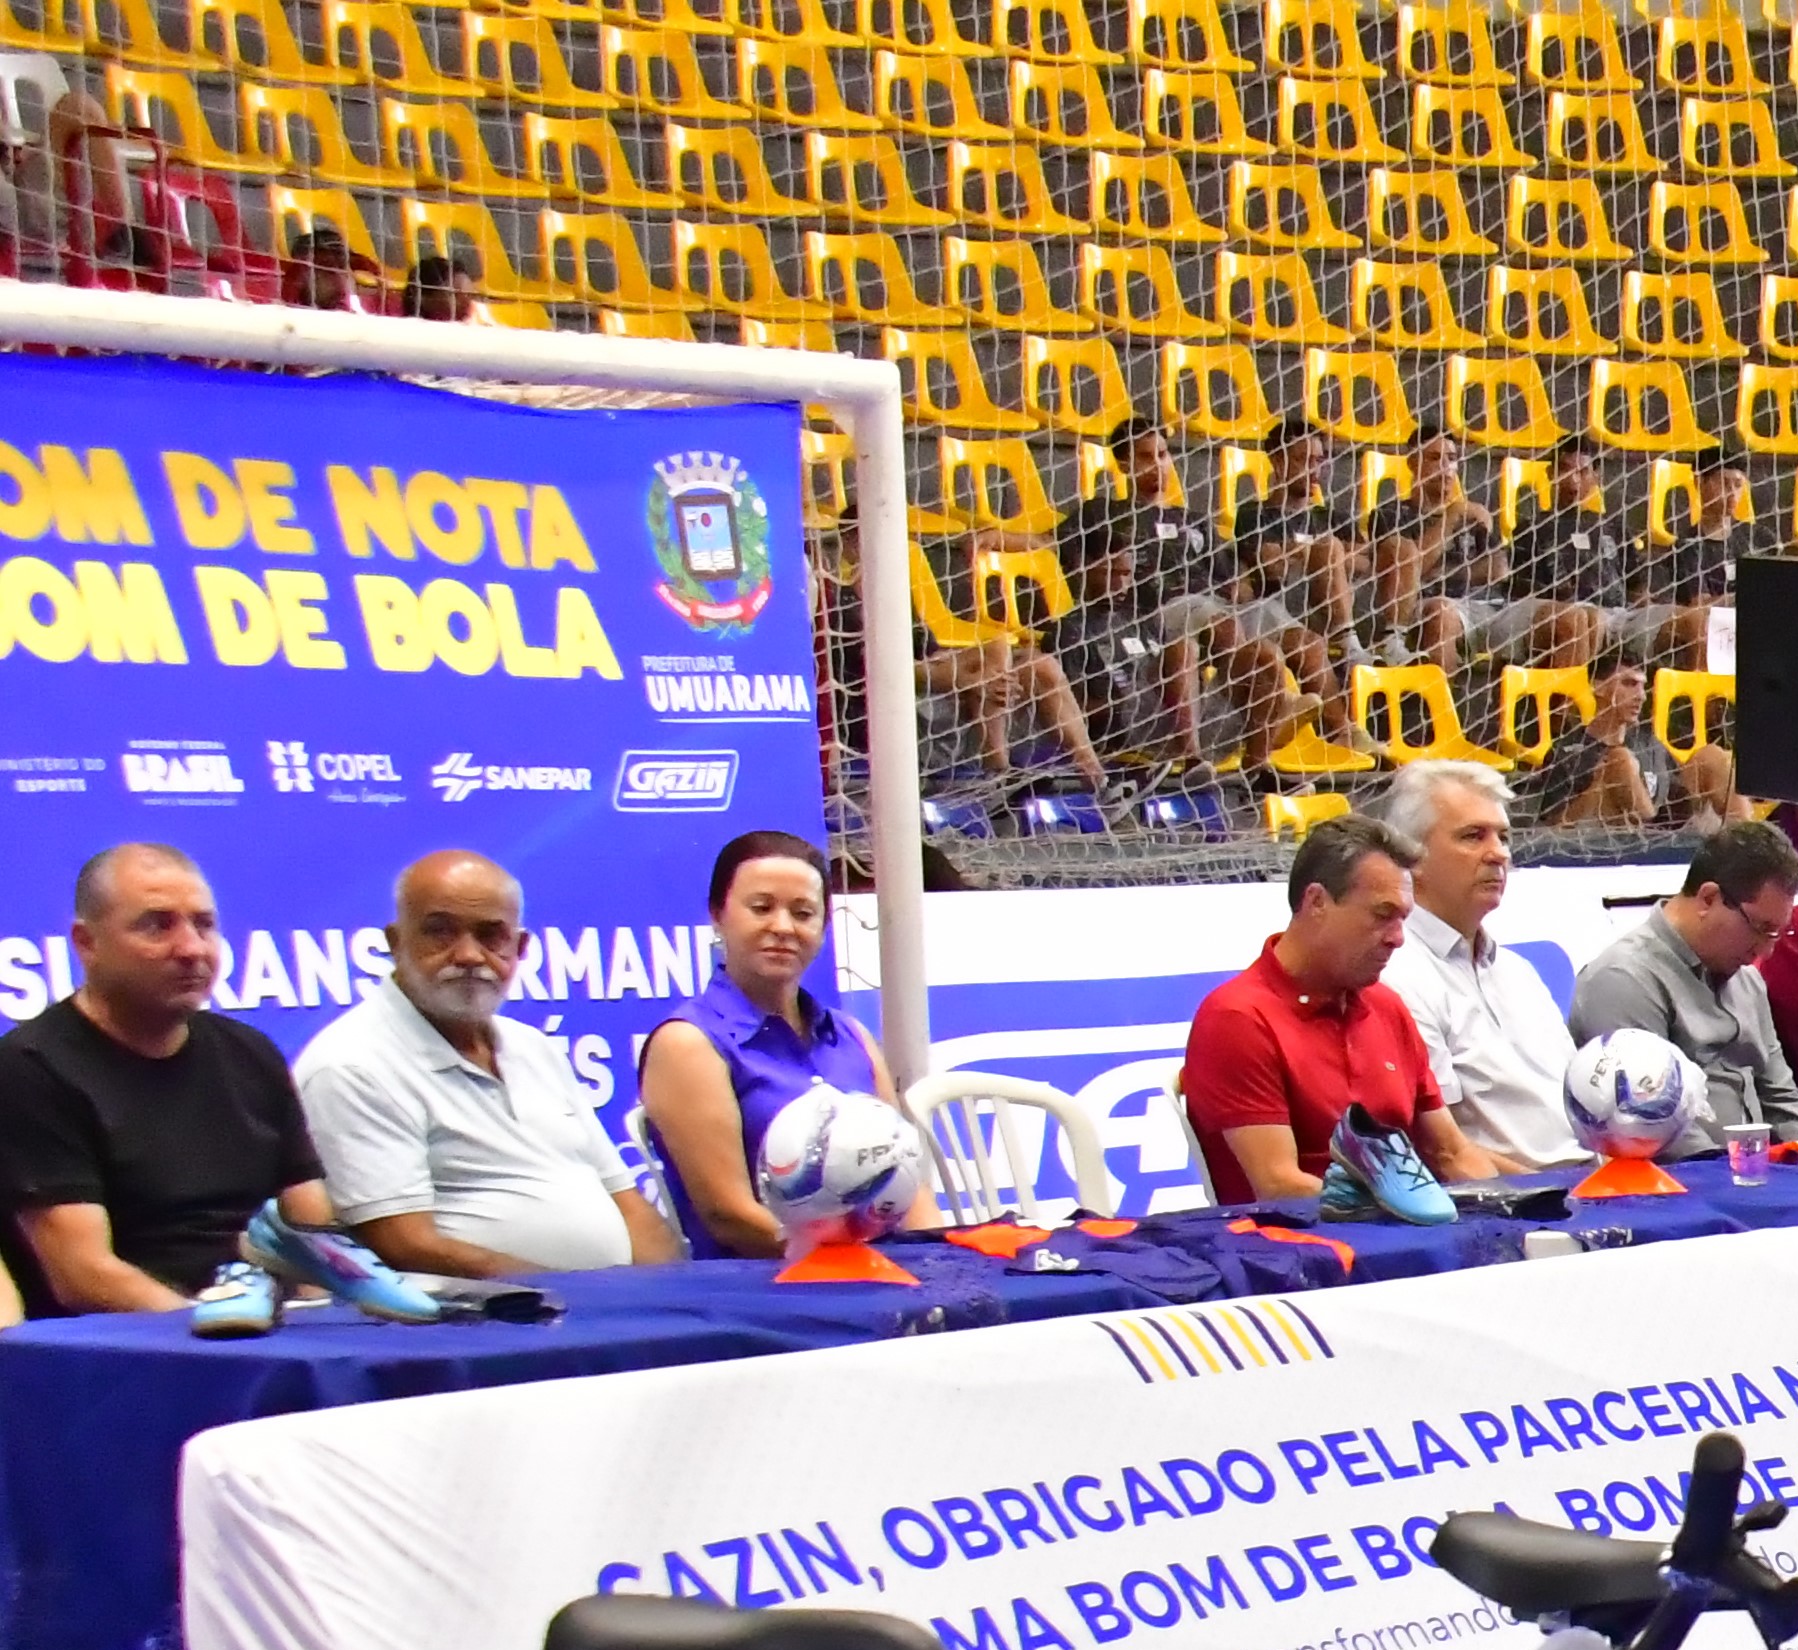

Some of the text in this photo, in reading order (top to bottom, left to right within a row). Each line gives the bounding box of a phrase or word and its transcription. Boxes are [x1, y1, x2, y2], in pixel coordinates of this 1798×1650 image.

[0, 437, 599, 574] OM DE NOTA
[0, 556, 624, 681] OM DE BOLA
[642, 655, 735, 673] PREFEITURA DE
[646, 674, 811, 713] UMUARAMA
[122, 753, 245, 792] BRASIL
[317, 753, 402, 782] COPEL
[485, 766, 592, 791] SANEPAR
[623, 761, 730, 799] GAZIN
[880, 1448, 1277, 1570] OBRIGADO
[1277, 1418, 1471, 1495] PELA
[1460, 1372, 1785, 1465] PARCERIA
[1065, 1555, 1251, 1645] BOM
[1244, 1533, 1358, 1603] DE
[1350, 1501, 1527, 1581] BO
